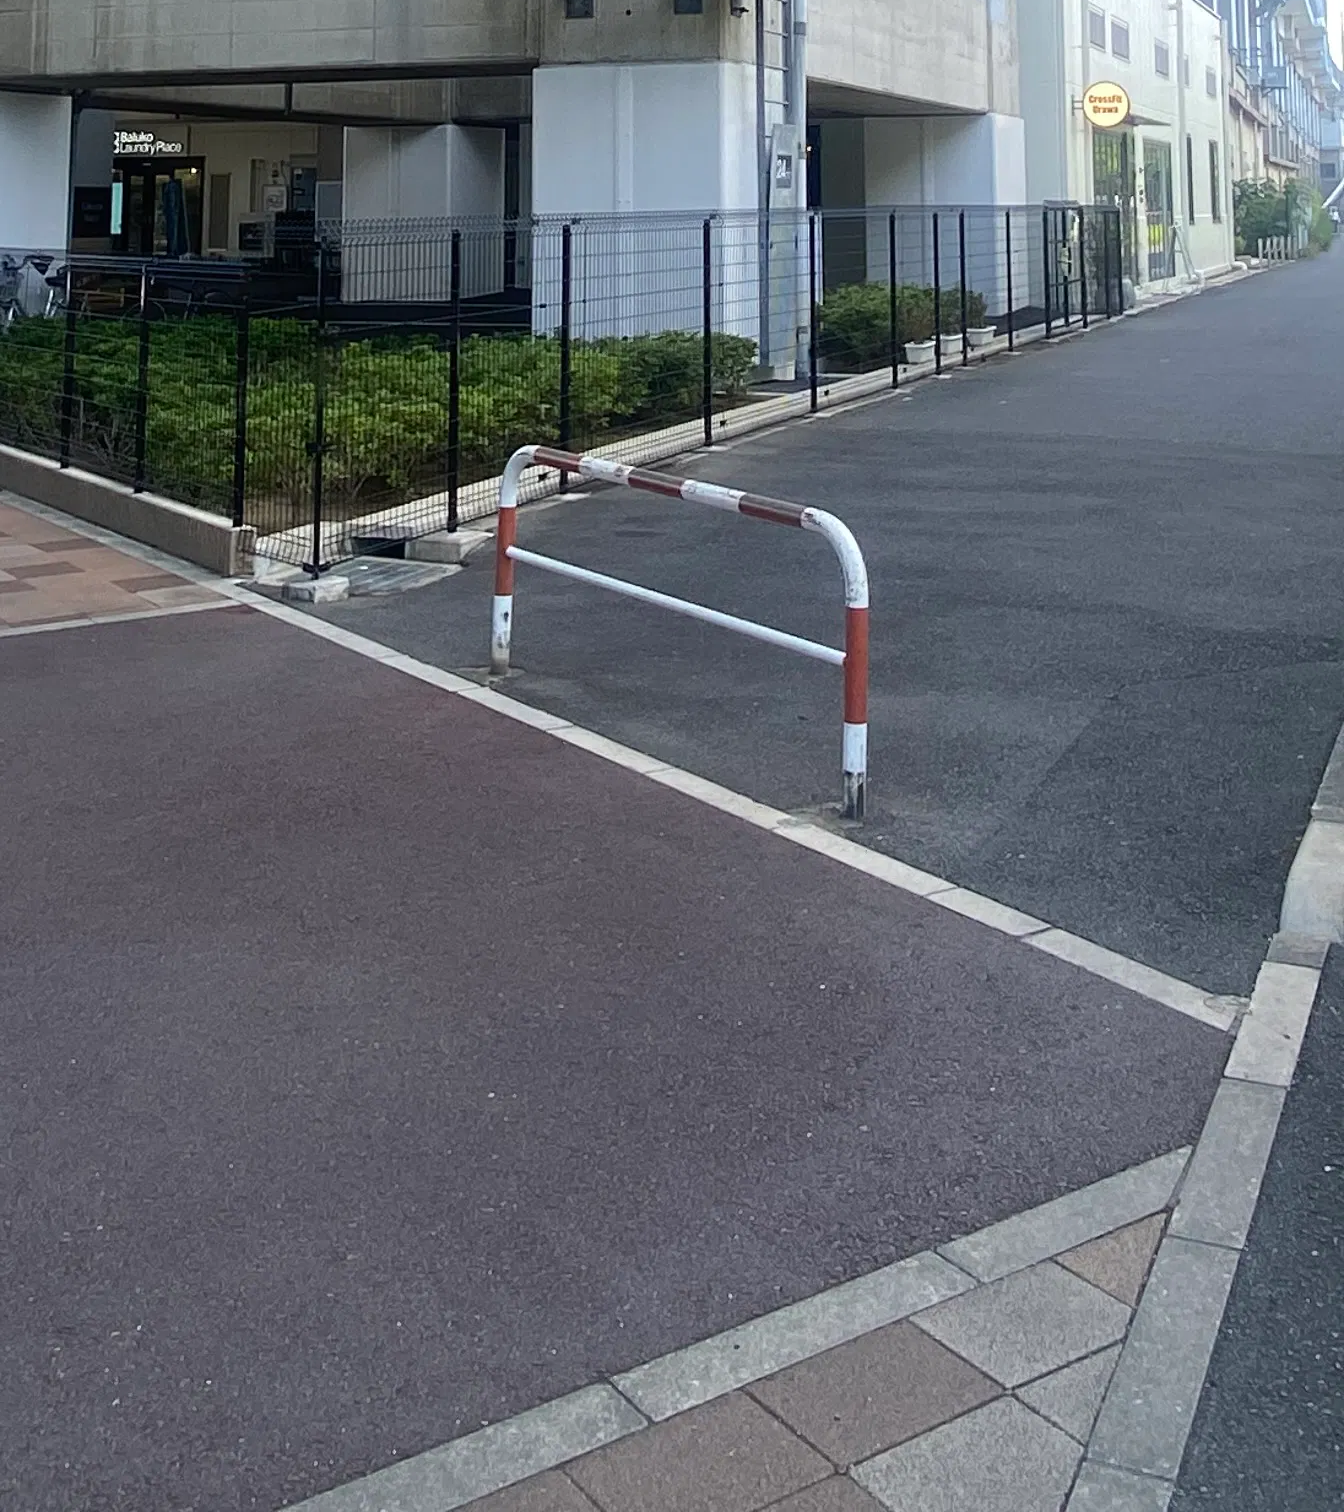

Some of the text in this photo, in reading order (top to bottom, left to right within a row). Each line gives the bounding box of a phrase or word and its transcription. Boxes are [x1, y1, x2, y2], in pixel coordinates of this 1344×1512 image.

[1088, 95, 1122, 103] CrossFit
[120, 132, 154, 142] Baluko
[120, 141, 182, 155] Laundry Place
